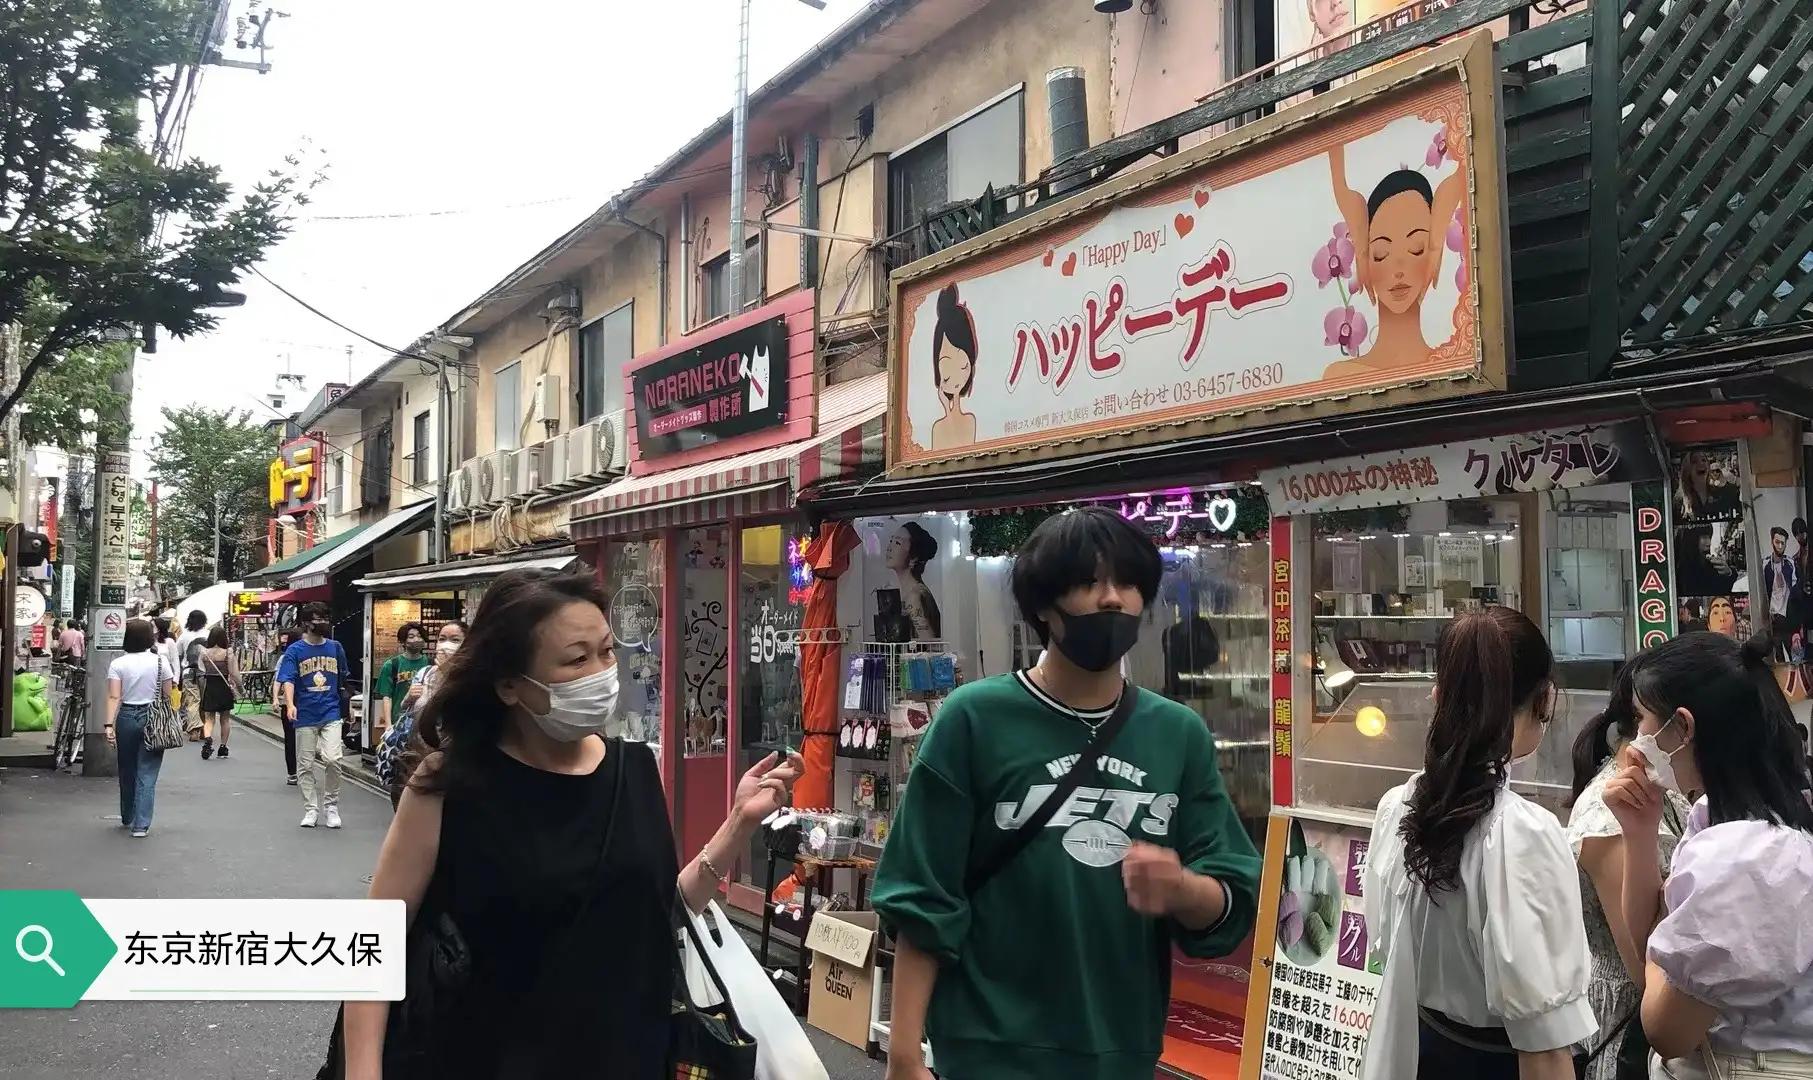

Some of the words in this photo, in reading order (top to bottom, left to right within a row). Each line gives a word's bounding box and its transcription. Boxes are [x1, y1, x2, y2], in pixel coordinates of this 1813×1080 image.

[1009, 247, 1289, 389] ハッピーデー
[644, 352, 741, 410] NORANEKO
[709, 390, 742, 422] 製作所
[1093, 385, 1170, 416] お問い合わせ
[1173, 362, 1283, 402] 03-6457-6830
[1278, 456, 1439, 502] 16,000本の神秘
[1463, 433, 1621, 490] クルタレ
[1096, 754, 1149, 787] YORK
[994, 783, 1180, 836] JETS
[825, 976, 853, 1001] QUEEN
[828, 961, 844, 981] Air
